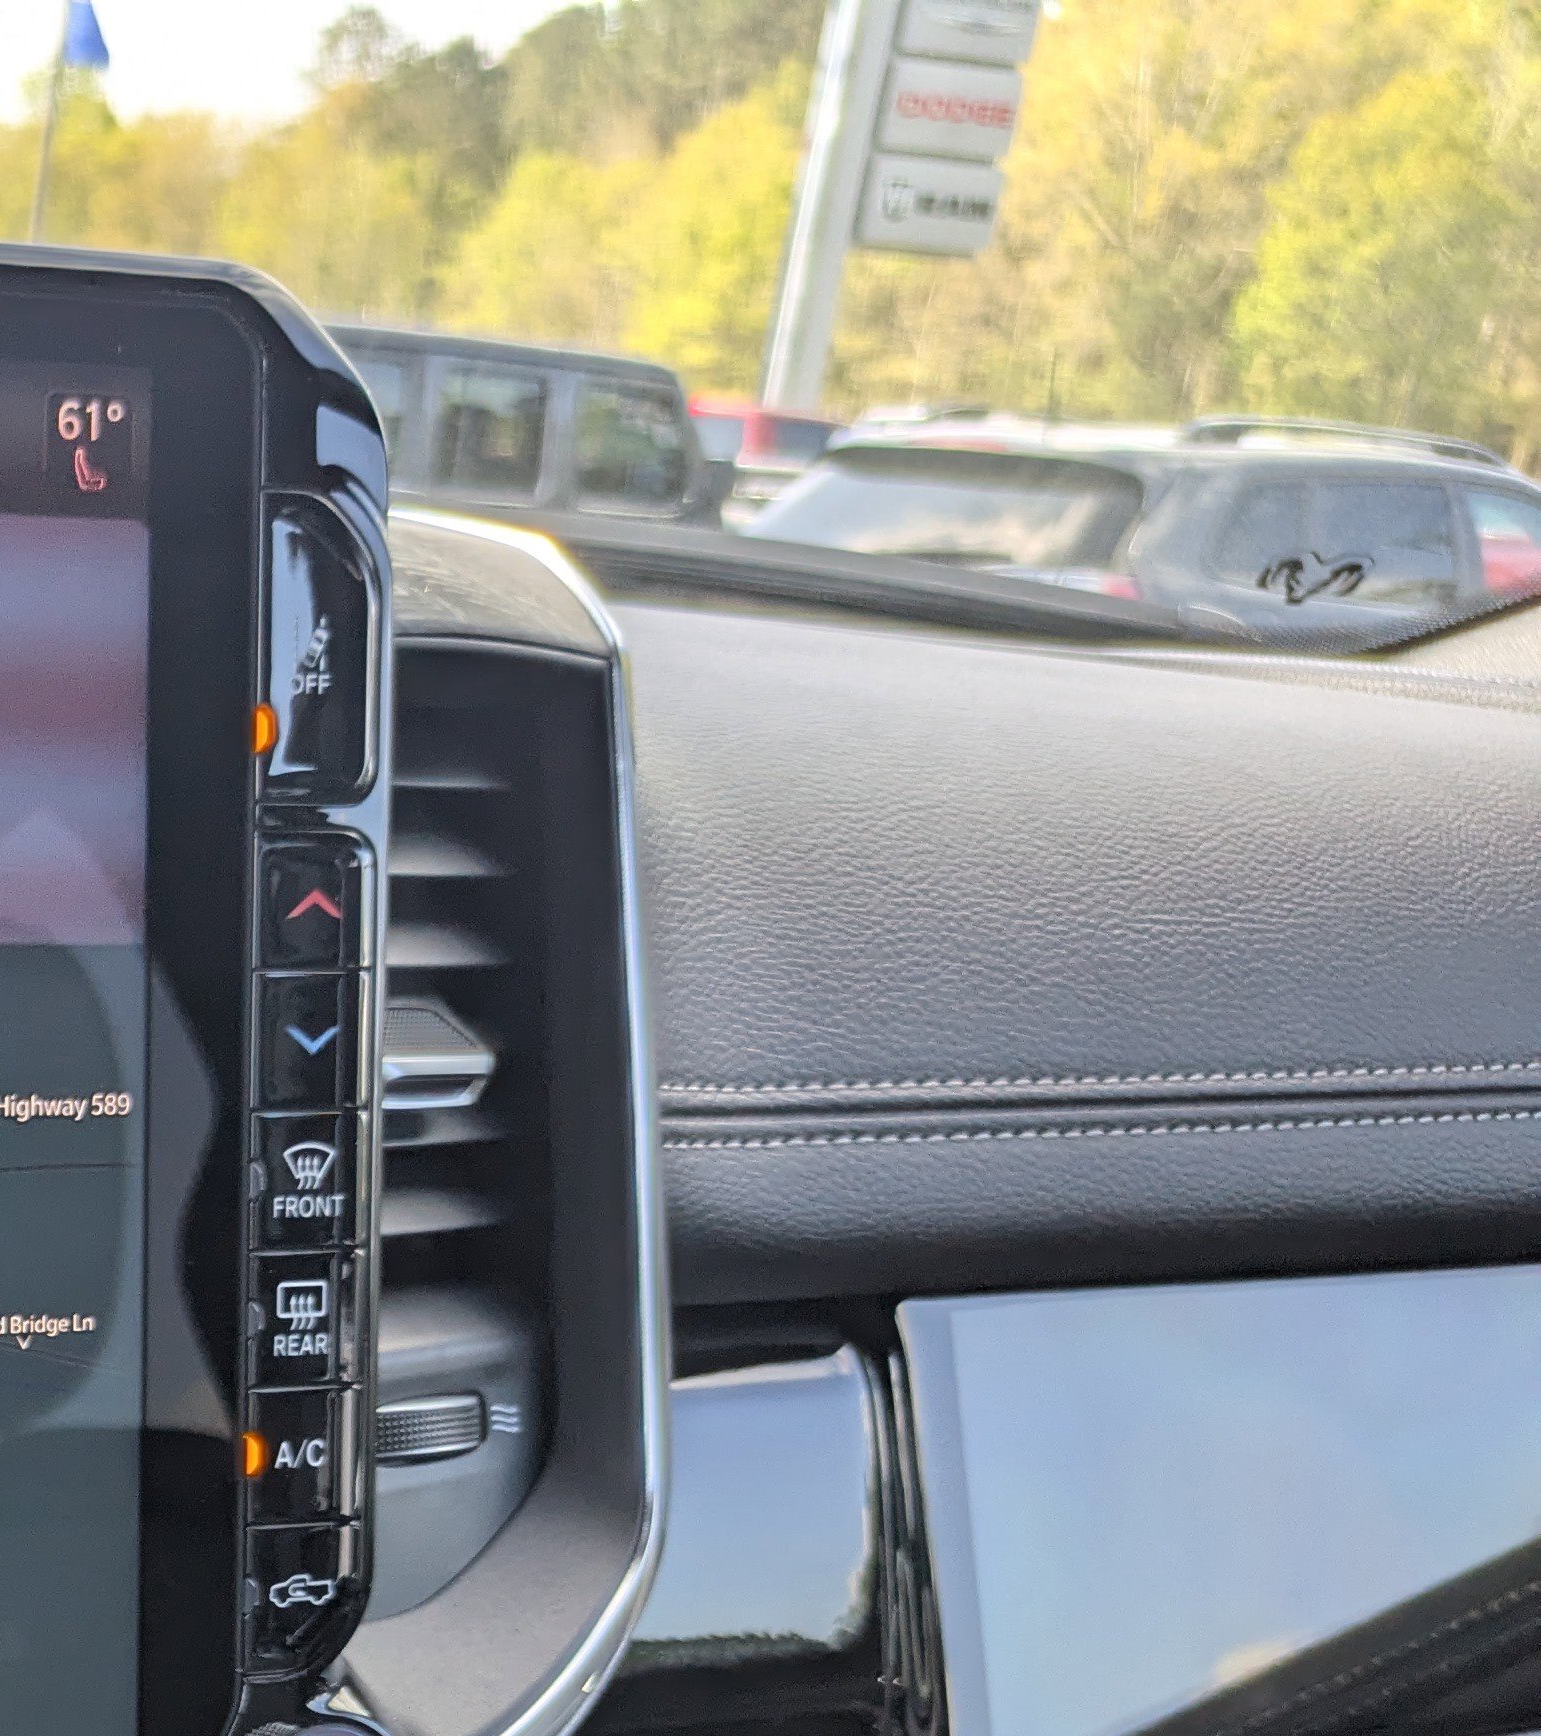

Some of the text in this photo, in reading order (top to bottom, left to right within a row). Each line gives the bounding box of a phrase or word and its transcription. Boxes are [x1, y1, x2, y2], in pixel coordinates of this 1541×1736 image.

[57, 399, 125, 441] 61°
[290, 672, 333, 695] OFF
[91, 1093, 131, 1116] 589
[273, 1195, 345, 1218] FRONT
[9, 1315, 70, 1338] Bridge
[72, 1314, 96, 1332] Ln
[273, 1334, 328, 1357] REAR
[274, 1437, 328, 1469] A/C
